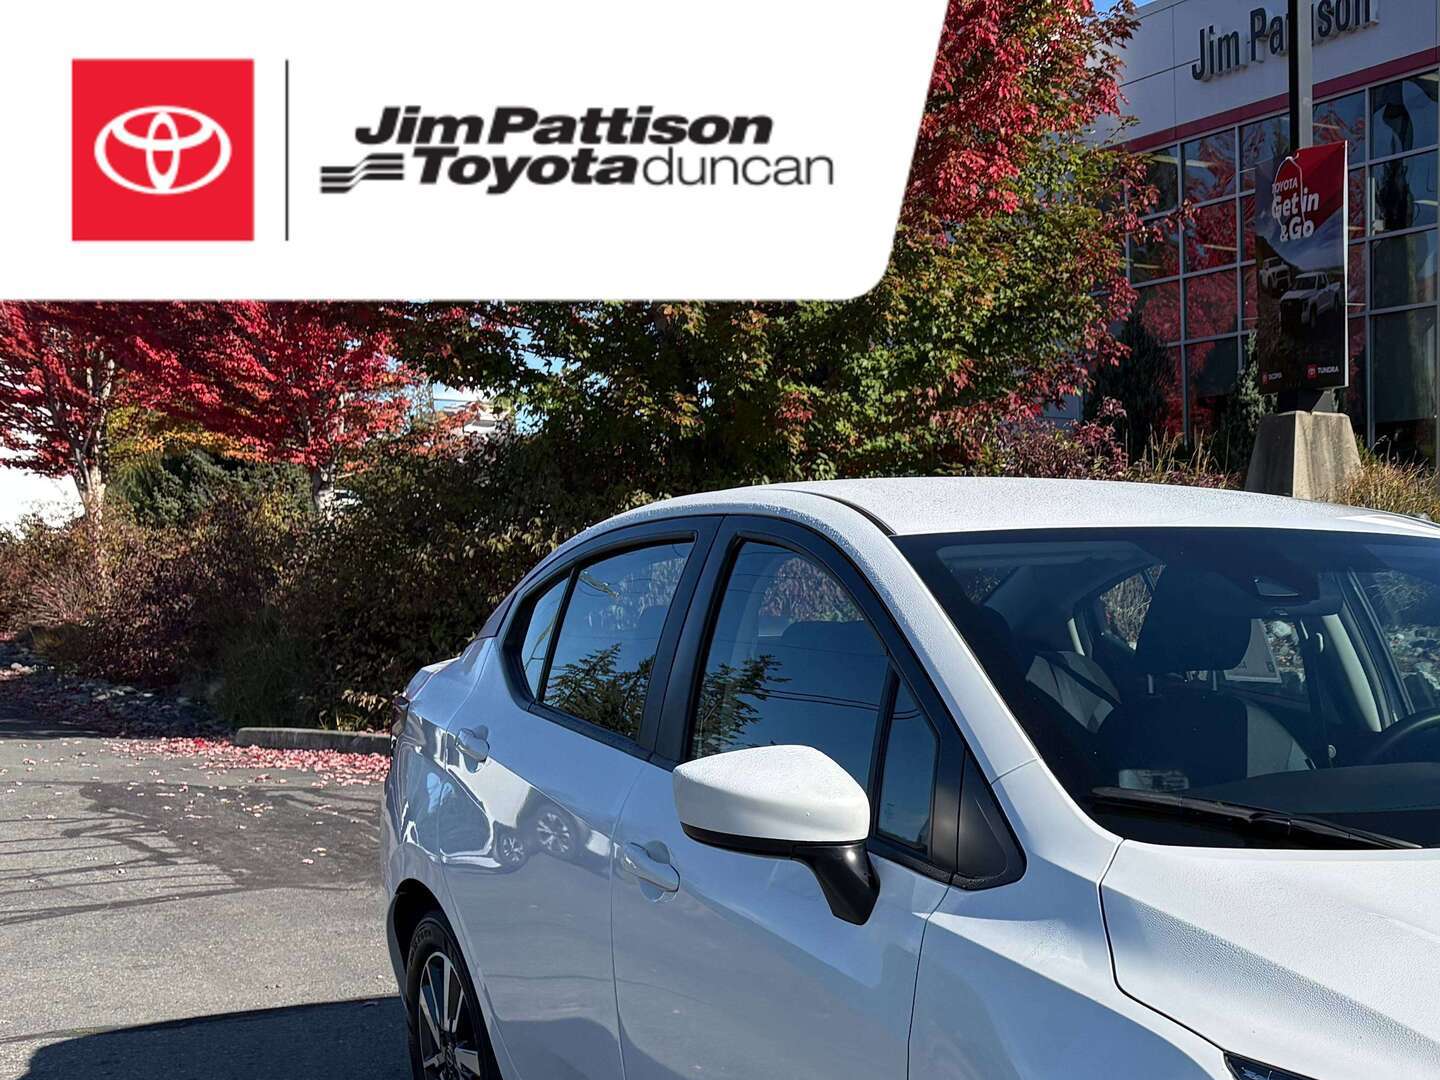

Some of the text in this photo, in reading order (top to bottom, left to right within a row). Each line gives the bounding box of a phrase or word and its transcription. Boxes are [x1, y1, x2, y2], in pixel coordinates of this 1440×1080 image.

[1192, 25, 1240, 80] Jim
[1271, 177, 1298, 194] TOYOTA
[1271, 187, 1320, 219] Get in
